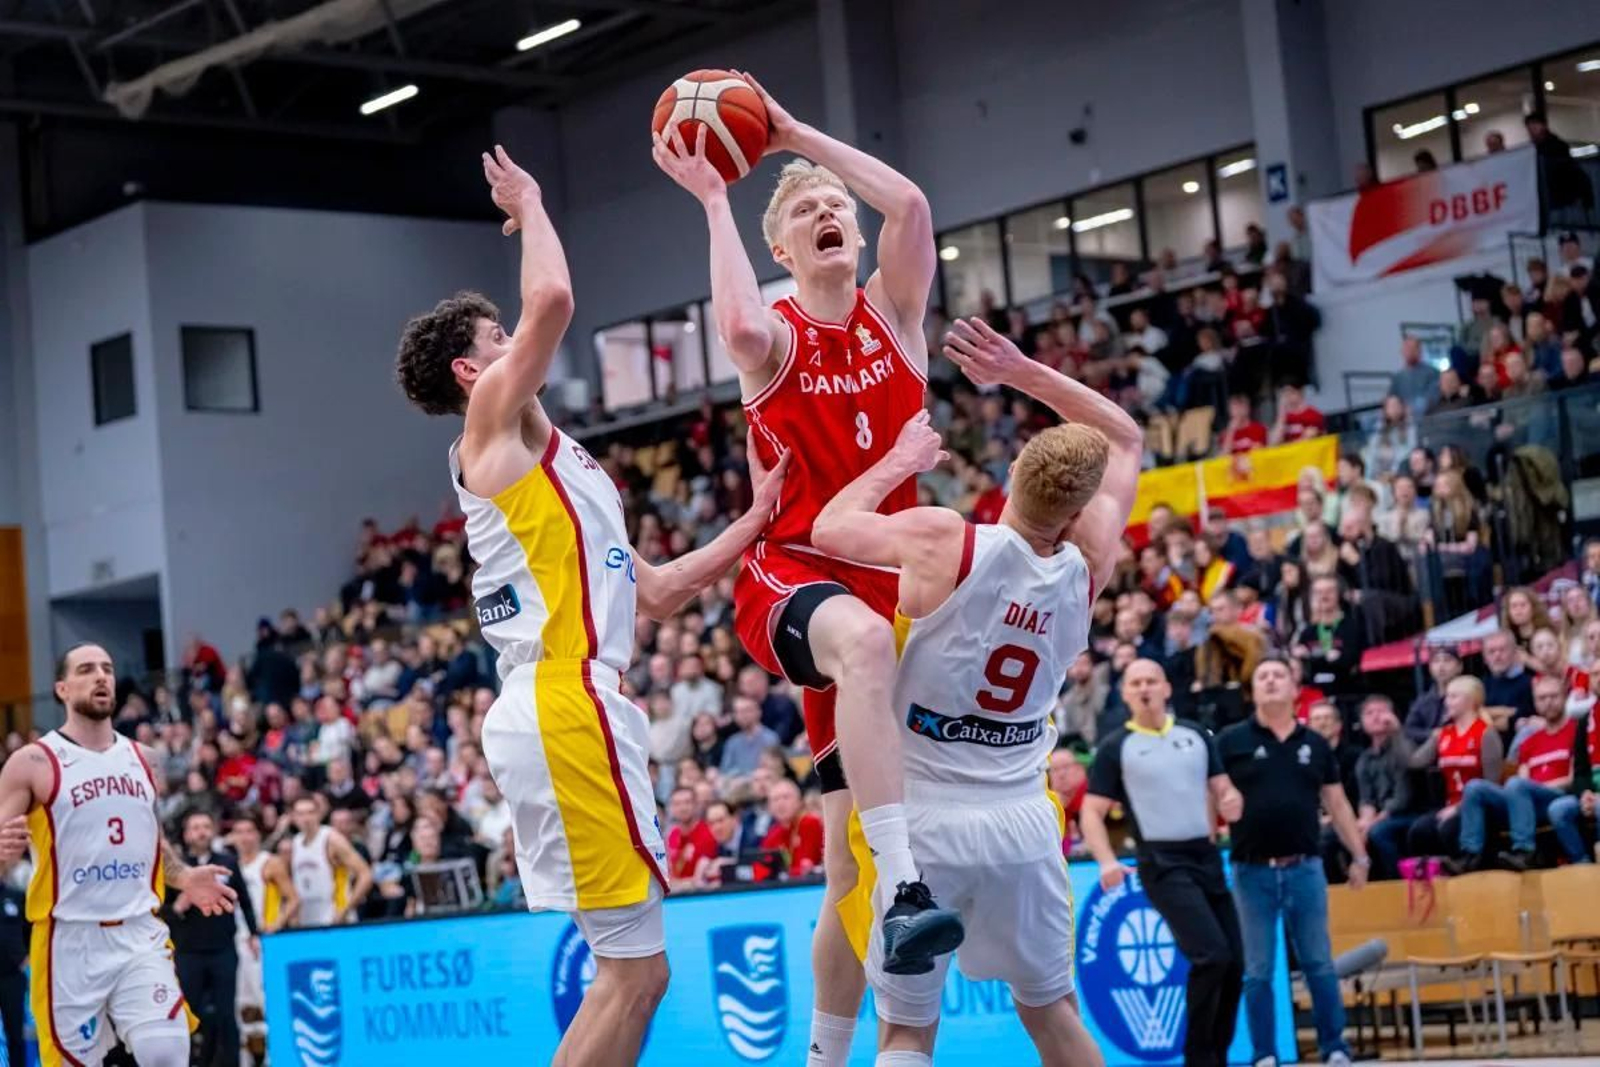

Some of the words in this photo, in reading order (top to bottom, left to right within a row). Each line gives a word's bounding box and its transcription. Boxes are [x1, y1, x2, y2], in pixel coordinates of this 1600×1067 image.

[1431, 183, 1508, 225] DBBF
[799, 352, 894, 395] DANMARK
[855, 411, 873, 450] 8
[1004, 600, 1053, 636] DÍAZ
[975, 643, 1041, 714] 9
[70, 773, 148, 808] ESPAÑA
[107, 816, 125, 845] 3
[360, 948, 475, 994] FURESØ
[364, 997, 510, 1045] KOMMUNE
